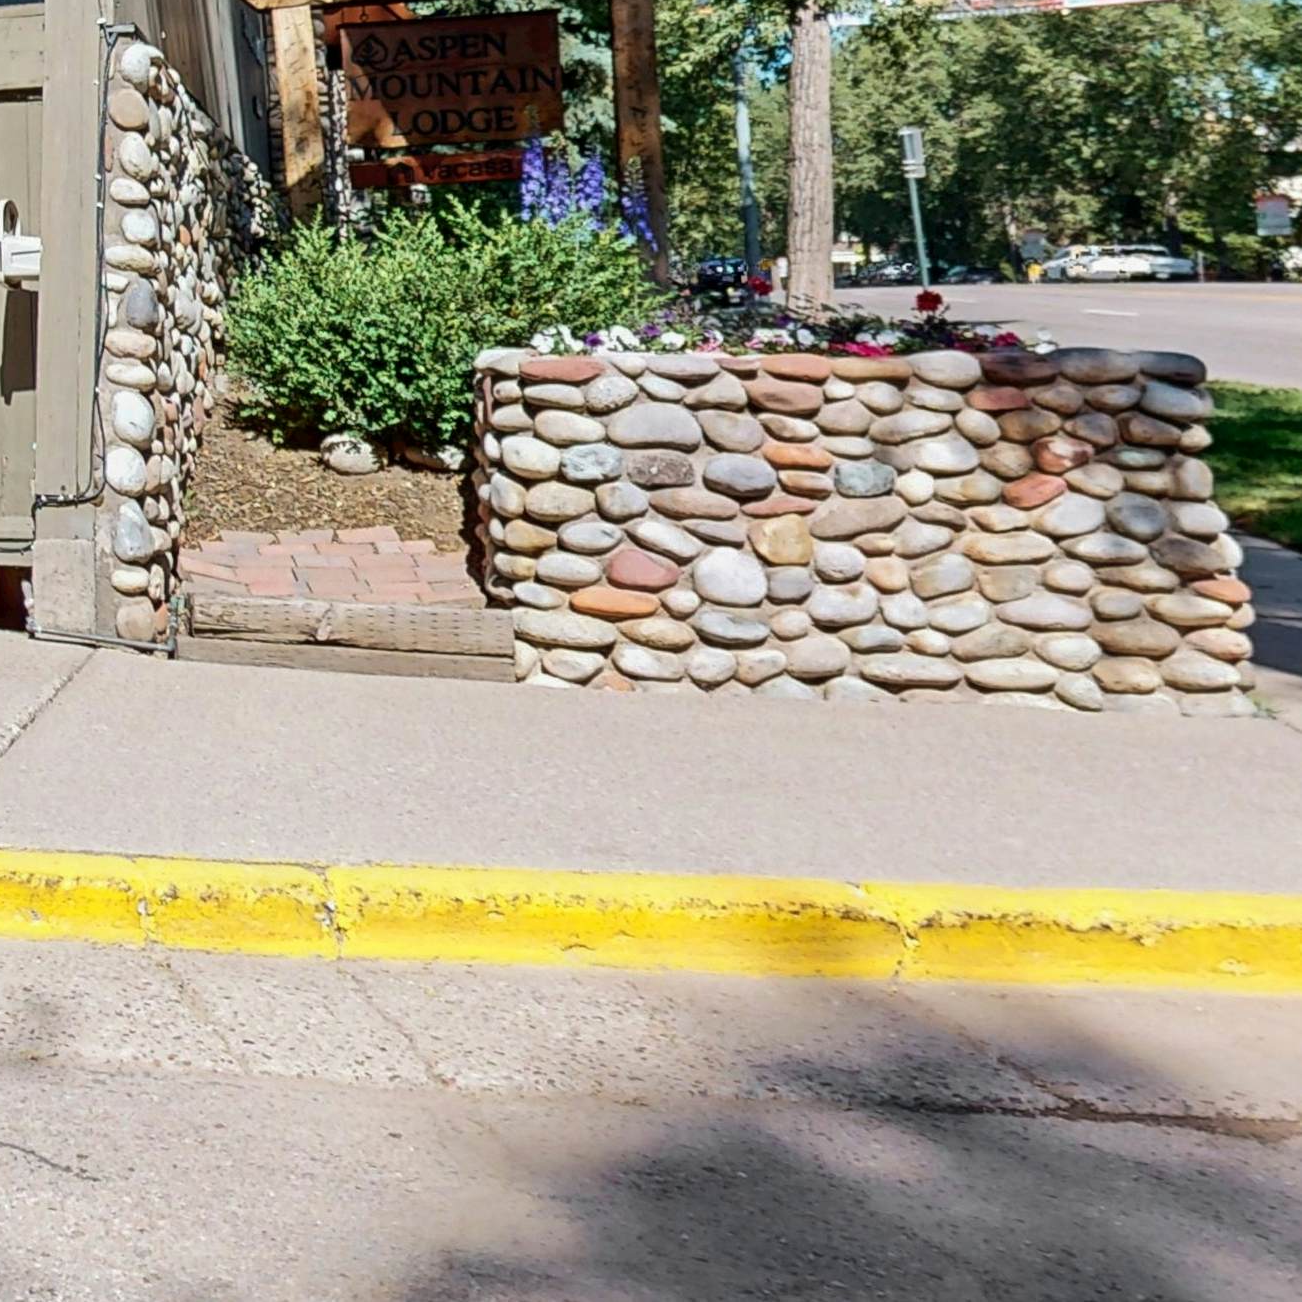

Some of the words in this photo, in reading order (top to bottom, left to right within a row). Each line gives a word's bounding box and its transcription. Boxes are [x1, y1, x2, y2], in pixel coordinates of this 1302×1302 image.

[395, 32, 507, 62] ASPEN
[350, 67, 558, 101] MOUNTAIN
[390, 106, 517, 136] LODGE
[423, 160, 513, 180] vacasa
